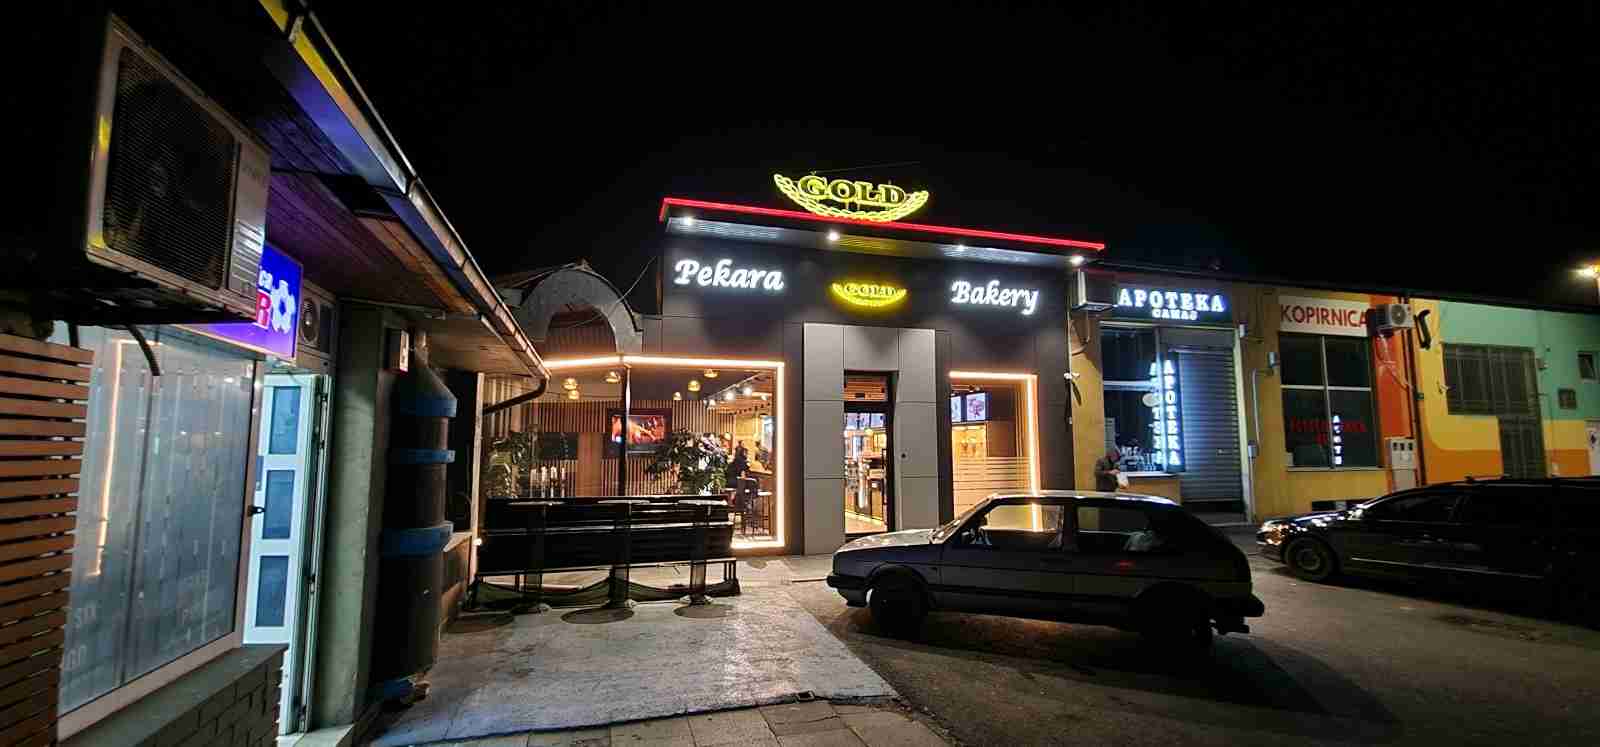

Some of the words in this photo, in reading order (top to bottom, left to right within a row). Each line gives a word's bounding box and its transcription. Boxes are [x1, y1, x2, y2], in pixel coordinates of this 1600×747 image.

[798, 175, 906, 207] GOLD
[674, 258, 785, 290] Pekara
[844, 282, 897, 298] GOLD
[951, 279, 1040, 315] Bakery
[1117, 288, 1226, 312] APOTEKA
[1280, 304, 1368, 328] KOPIRNICA
[1163, 359, 1181, 466] APOTEKA
